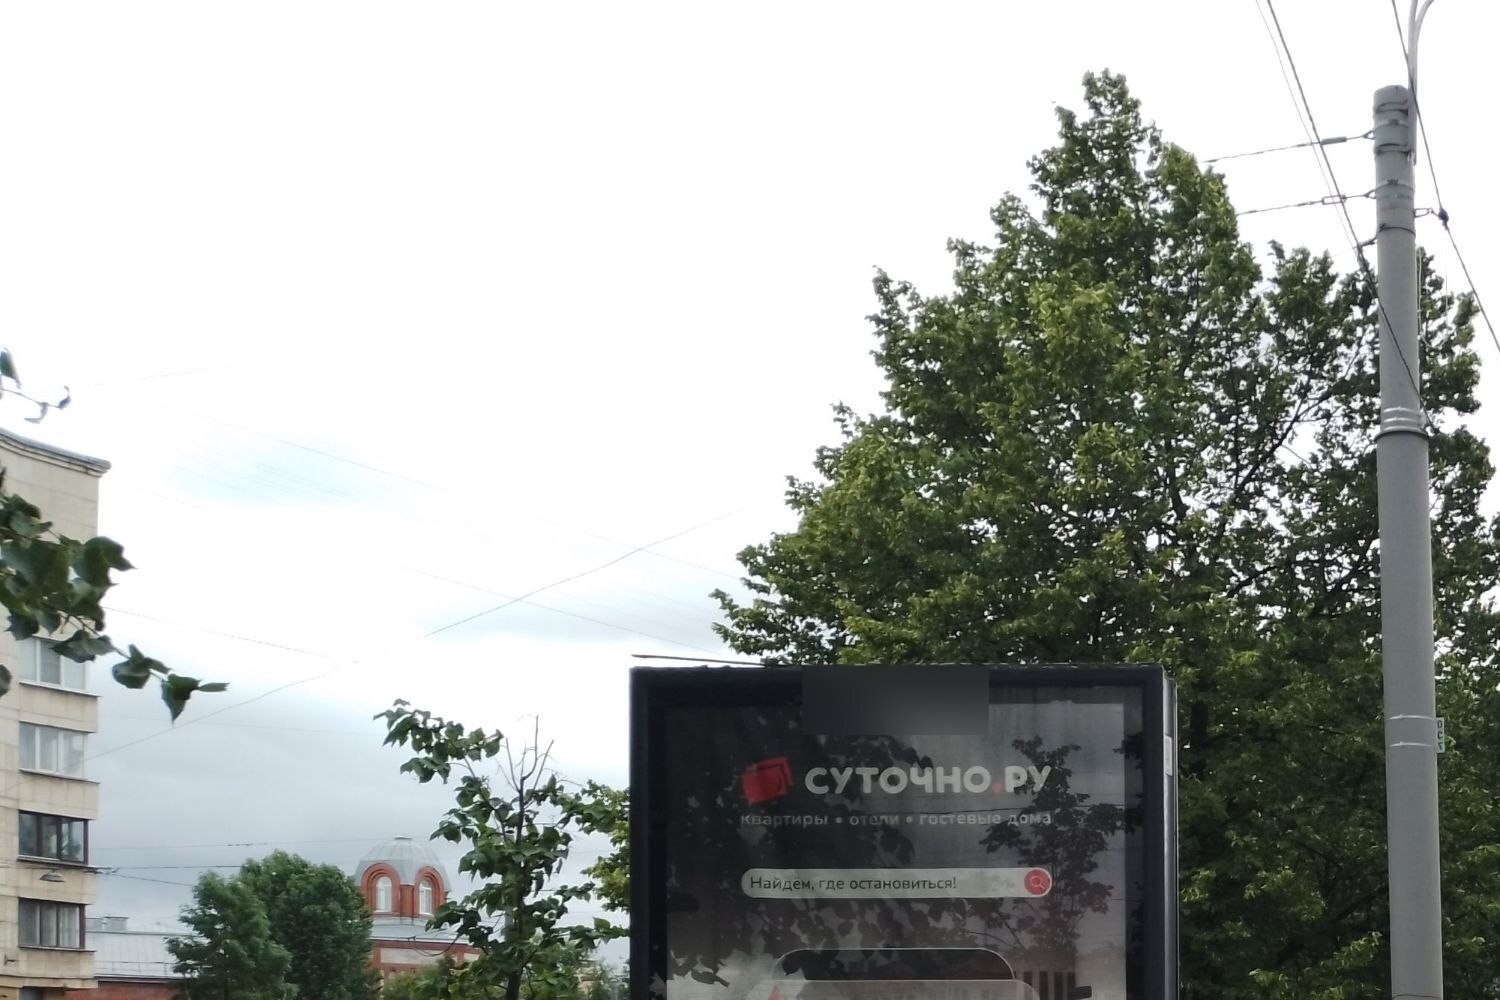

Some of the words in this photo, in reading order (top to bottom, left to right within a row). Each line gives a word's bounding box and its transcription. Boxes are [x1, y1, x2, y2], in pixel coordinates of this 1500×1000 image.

[804, 765, 1051, 795] СУТОЧНО.РУ
[740, 814, 829, 828] квартиры
[849, 814, 900, 826] отели
[919, 813, 1001, 826] гостевые
[1007, 812, 1052, 827] дома
[750, 876, 815, 892] Найдём,
[818, 881, 845, 892] где
[849, 876, 957, 891] остановиться!
